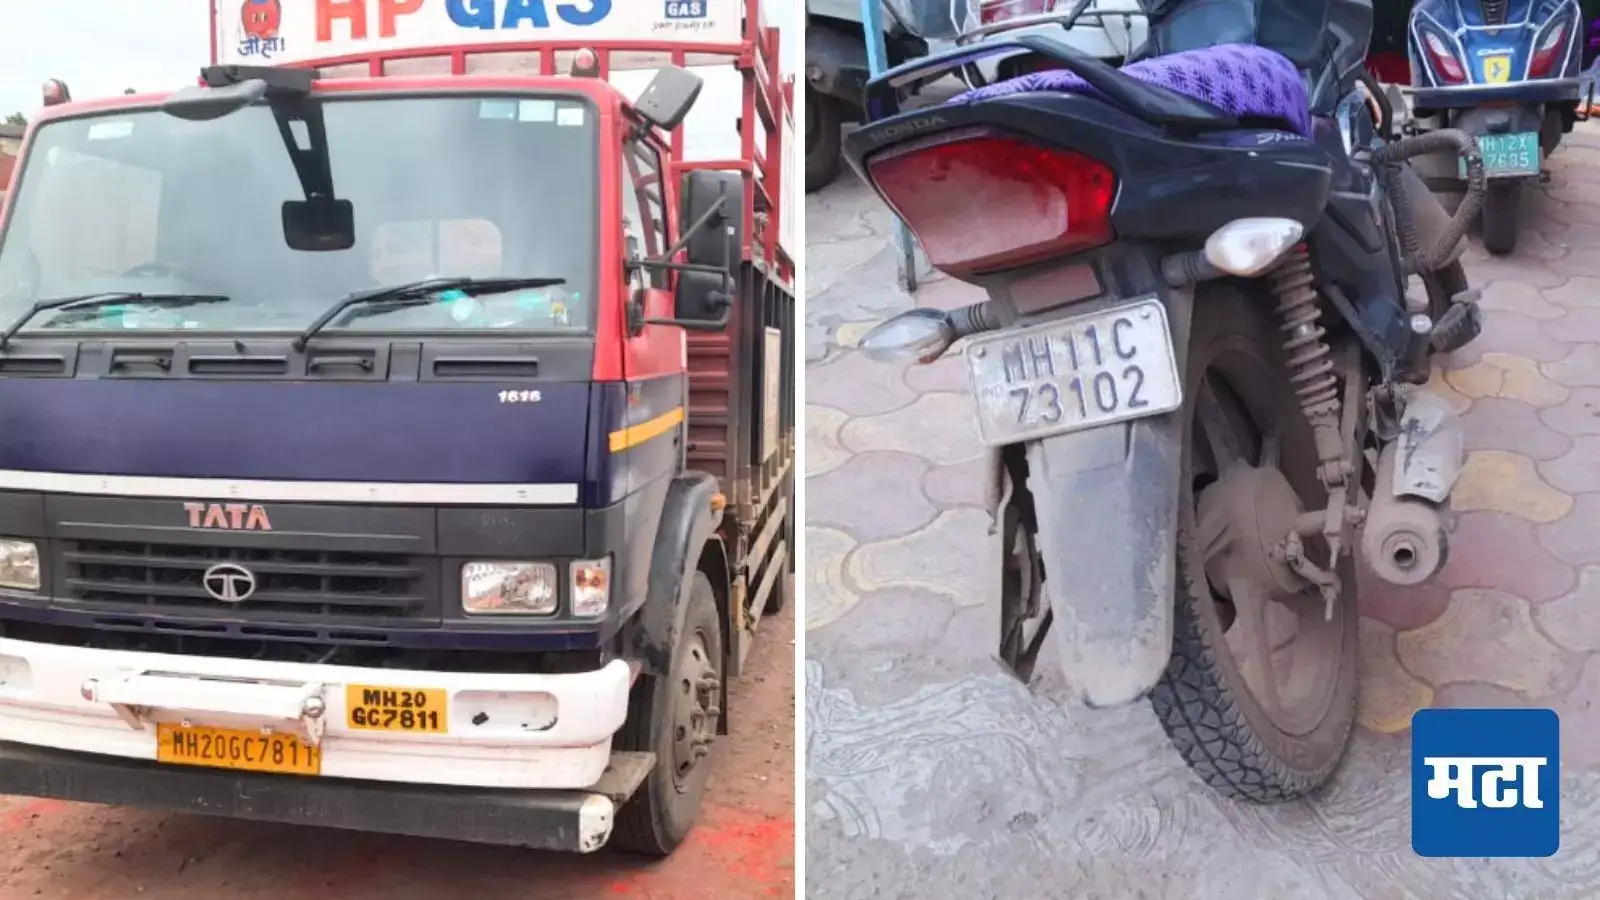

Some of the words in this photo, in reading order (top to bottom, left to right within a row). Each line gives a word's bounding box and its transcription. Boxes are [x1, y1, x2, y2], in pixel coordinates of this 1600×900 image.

[315, 0, 424, 41] HP
[444, 0, 612, 29] GAS
[667, 3, 702, 16] GAS
[1003, 317, 1137, 384] MH11C
[497, 389, 542, 403] 1616
[183, 502, 272, 531] TATA
[172, 730, 314, 767] MH20GC7811
